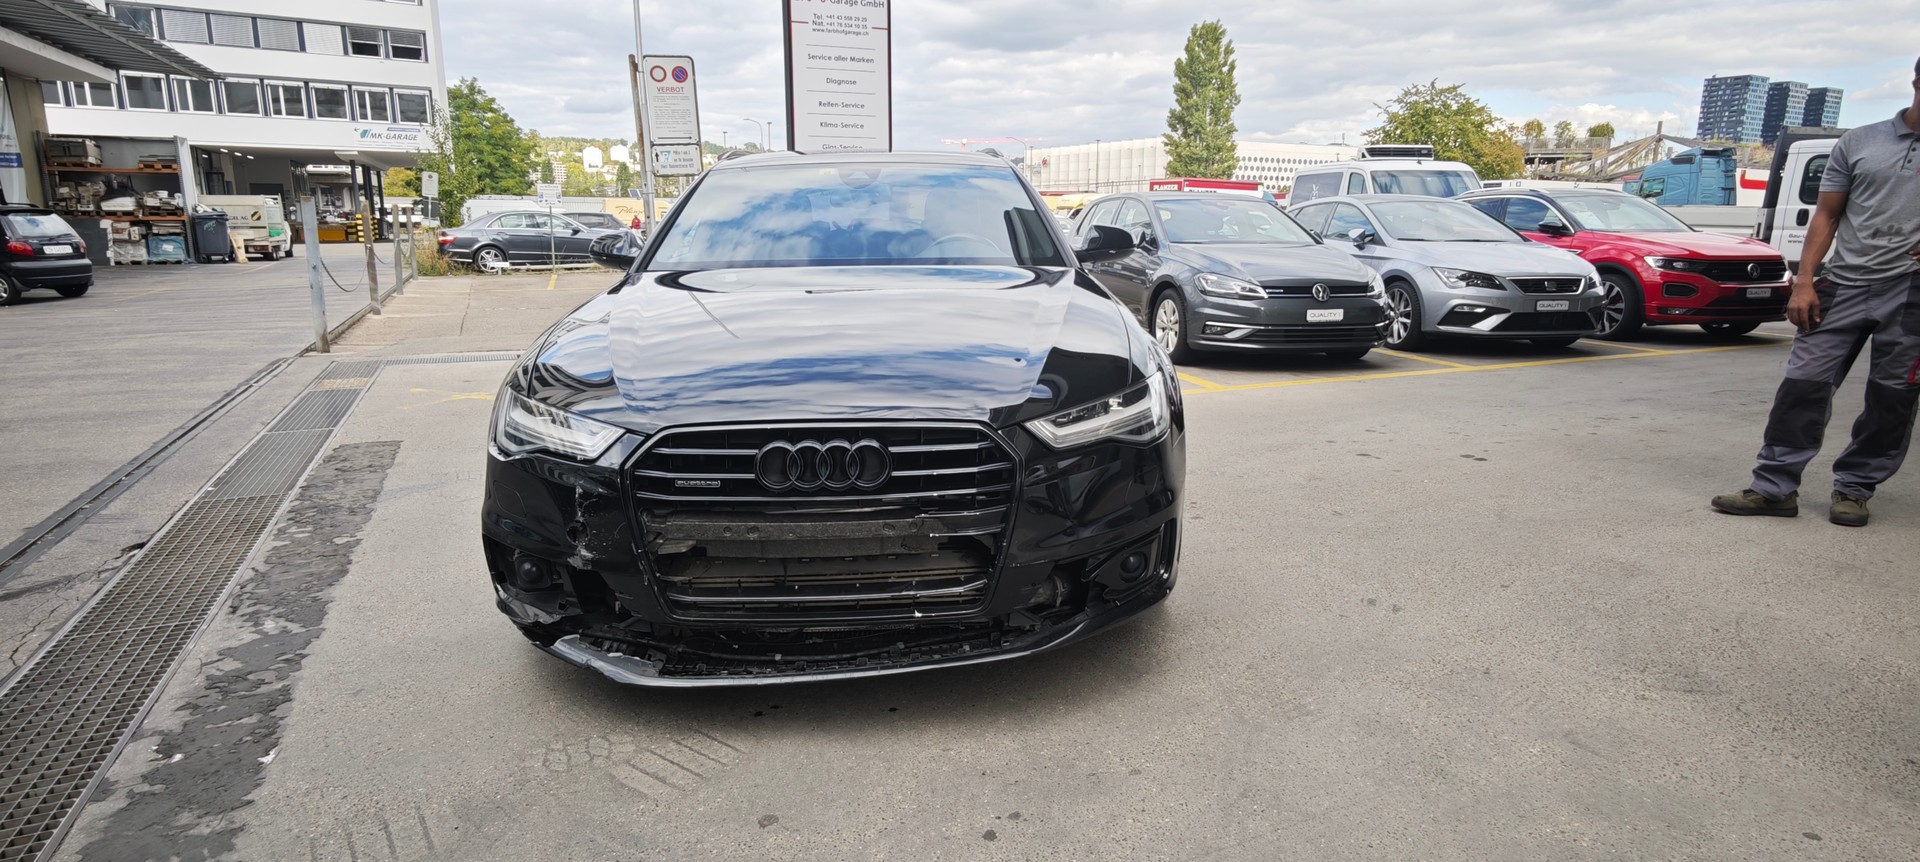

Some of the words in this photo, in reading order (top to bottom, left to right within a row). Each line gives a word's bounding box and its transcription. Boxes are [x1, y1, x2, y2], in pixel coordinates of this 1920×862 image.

[812, 28, 869, 36] www.farbhofgarage.ch
[807, 53, 832, 61] Service
[833, 54, 848, 62] aller
[826, 77, 857, 86] Diagnose
[818, 100, 865, 109] Reifen-Service
[819, 121, 865, 129] Klima-Service
[369, 132, 419, 141] MK-GARAGE
